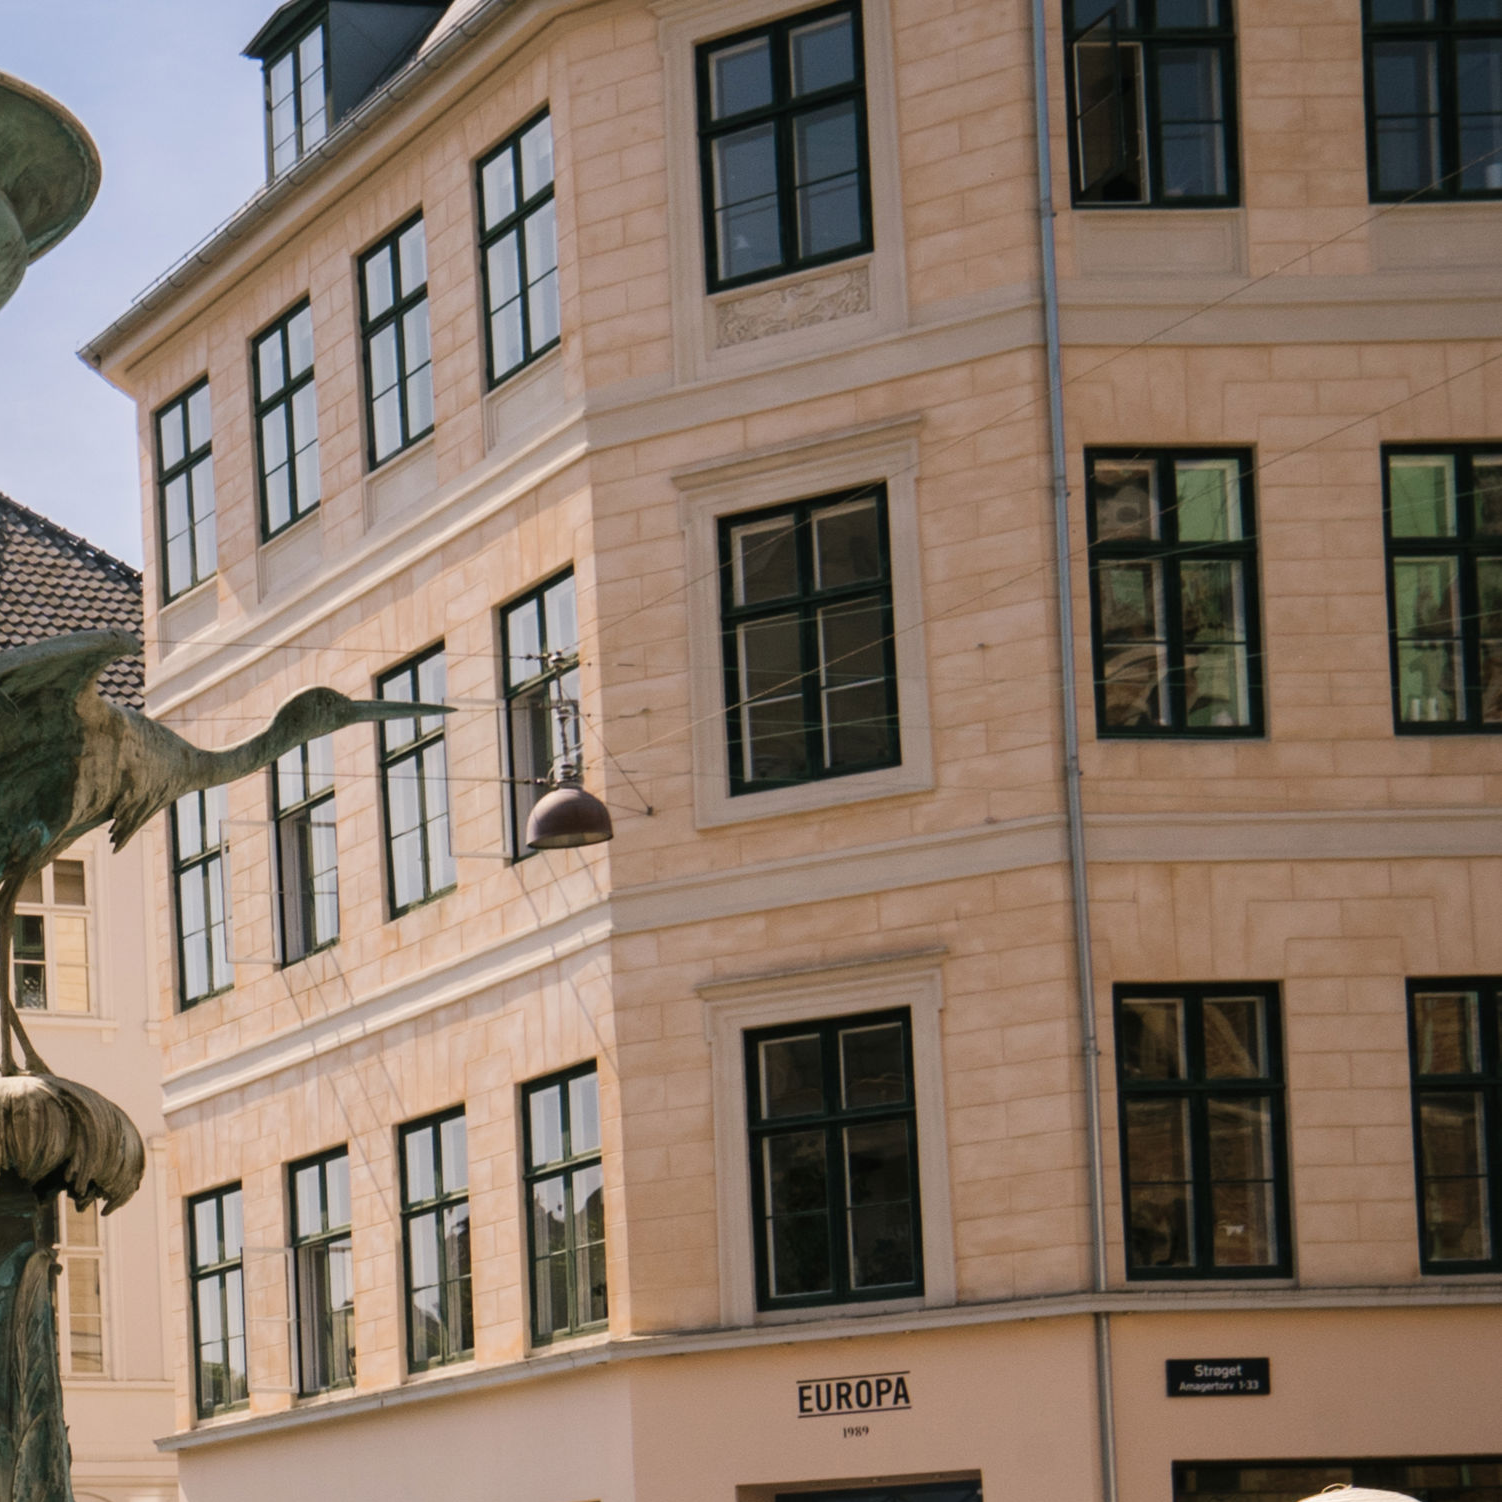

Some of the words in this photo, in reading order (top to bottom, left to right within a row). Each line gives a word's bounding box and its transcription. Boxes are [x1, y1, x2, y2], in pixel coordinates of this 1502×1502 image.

[1194, 1364, 1243, 1379] Strøget
[1179, 1381, 1234, 1393] Amagertorv
[1238, 1380, 1260, 1390] 1-33
[798, 1376, 910, 1413] EUROPA
[842, 1425, 870, 1438] 1989
